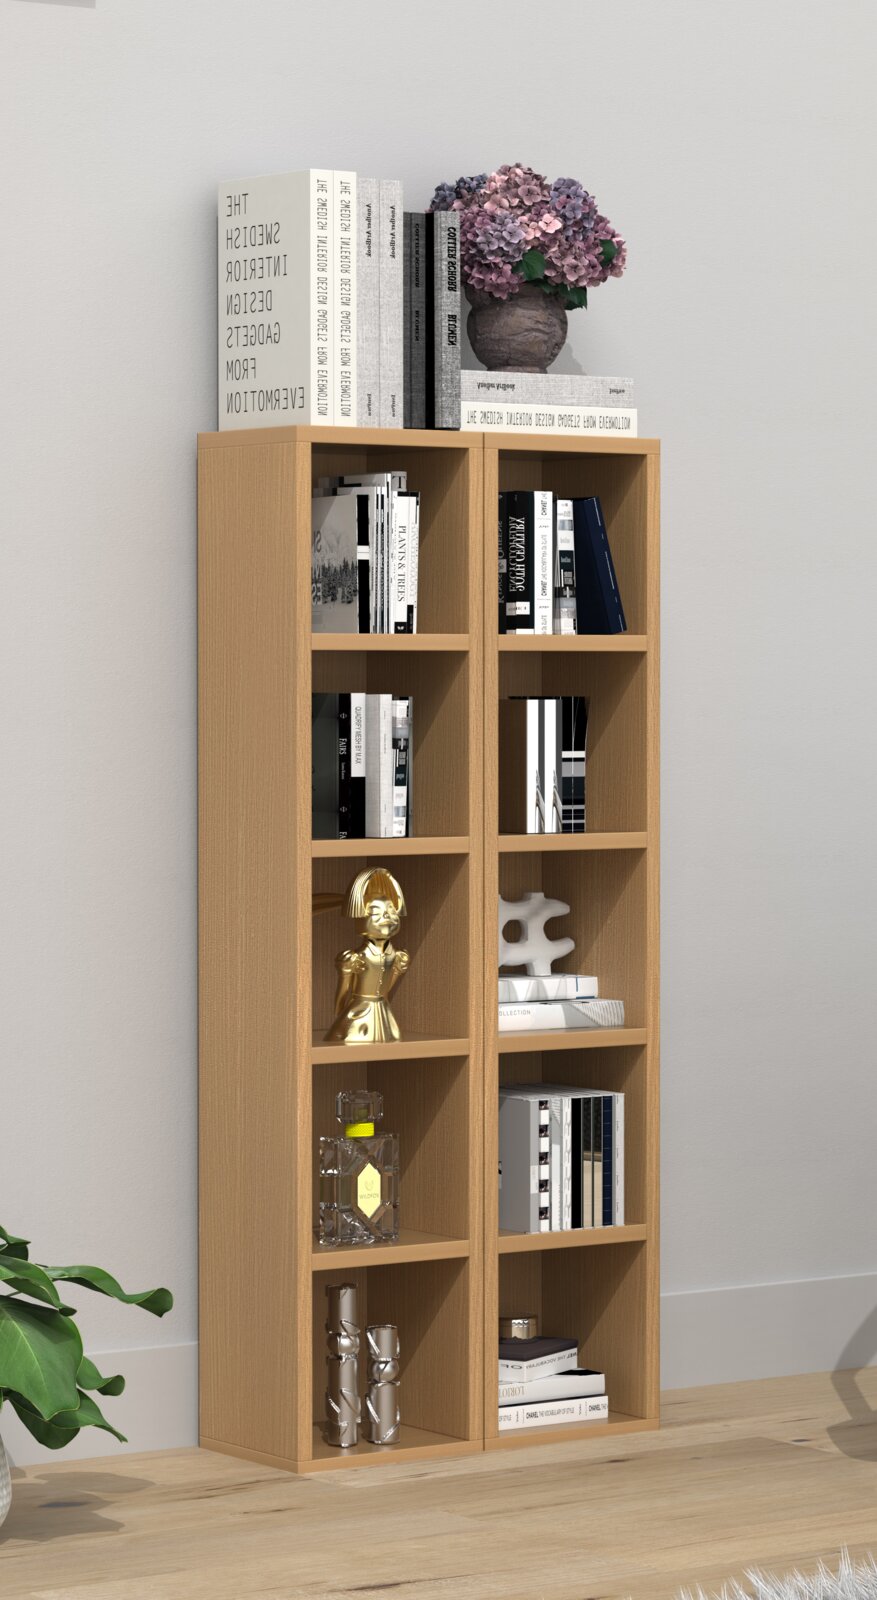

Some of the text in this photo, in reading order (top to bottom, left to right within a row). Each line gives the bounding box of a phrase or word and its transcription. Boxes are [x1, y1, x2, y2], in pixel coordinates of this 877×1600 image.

[398, 525, 407, 561] PLANTS
[397, 573, 406, 602] TREES
[499, 1009, 531, 1017] OLLECTION
